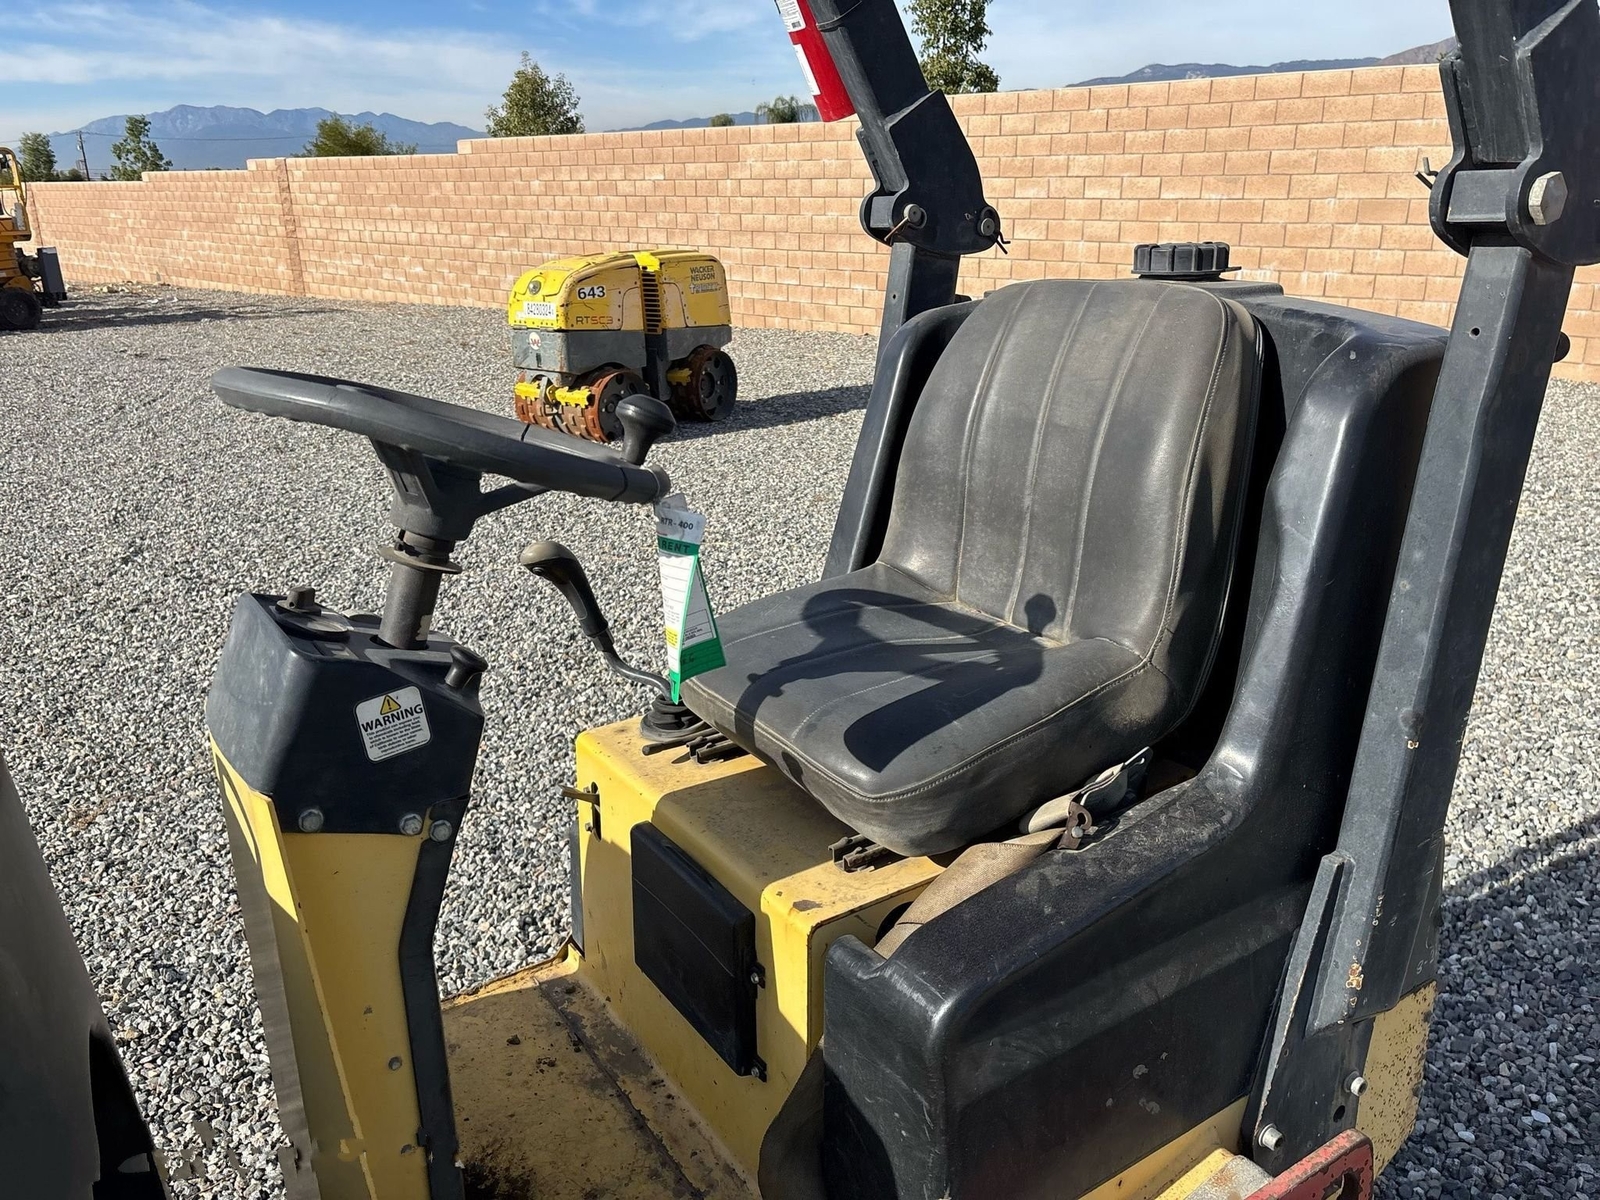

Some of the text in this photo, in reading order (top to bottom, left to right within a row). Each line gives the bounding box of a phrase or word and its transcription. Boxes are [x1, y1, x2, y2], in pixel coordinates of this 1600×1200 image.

[690, 265, 714, 274] WACKER
[691, 273, 715, 281] NEUSON
[577, 285, 606, 300] 643
[661, 540, 690, 553] RENT
[361, 703, 423, 733] WARNING
